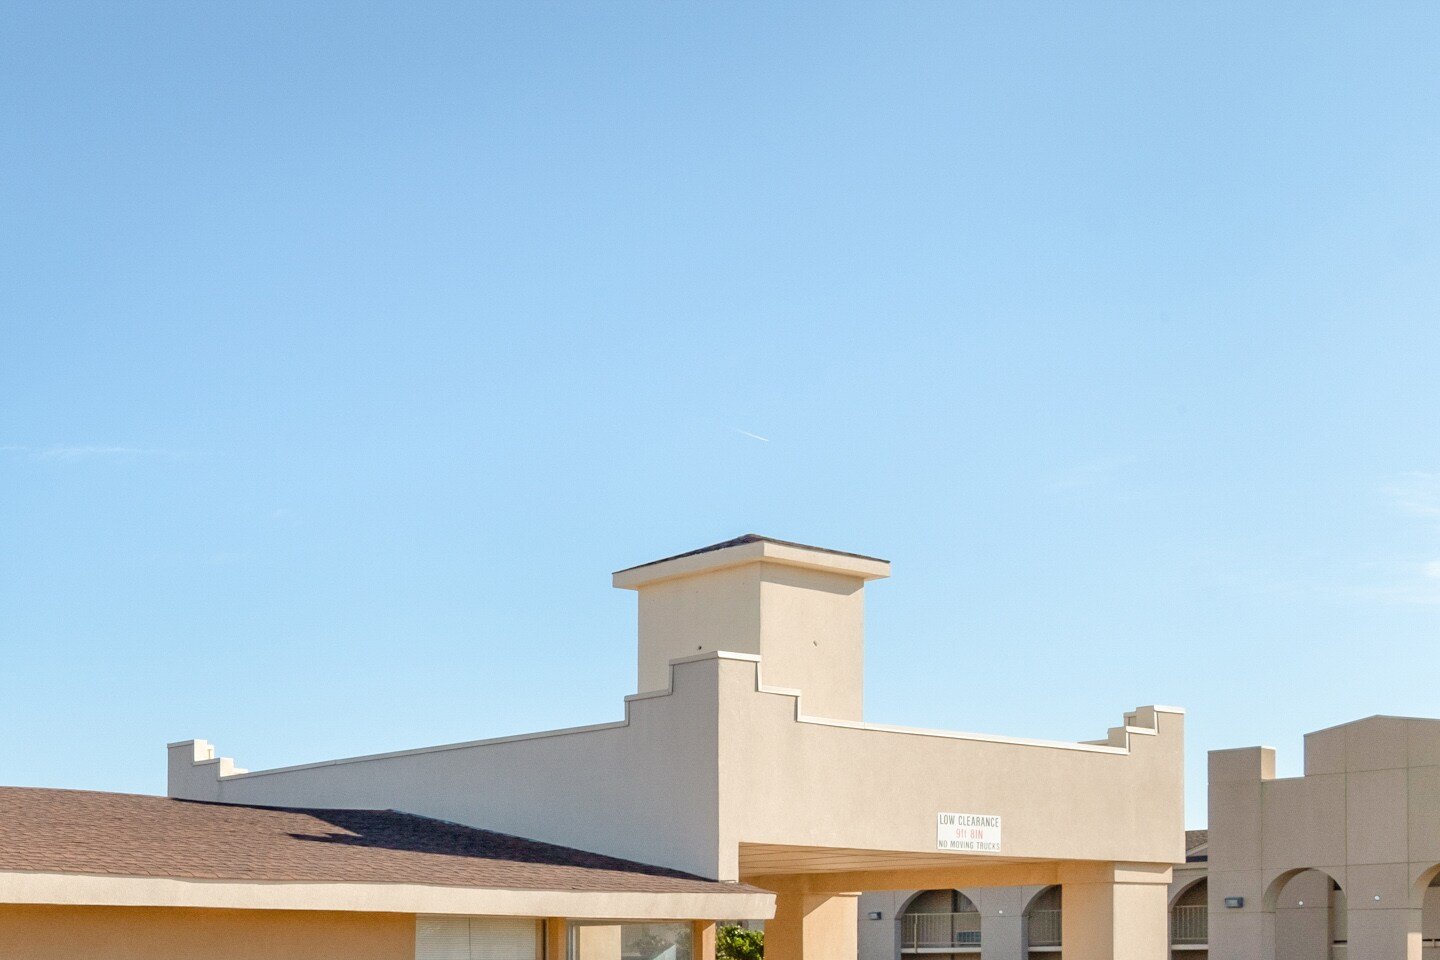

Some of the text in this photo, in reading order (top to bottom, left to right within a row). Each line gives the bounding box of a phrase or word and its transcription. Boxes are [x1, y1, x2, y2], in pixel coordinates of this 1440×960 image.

[939, 814, 999, 828] LOW CLEARANCE
[938, 840, 1000, 850] NO MOVING TRUCKS
